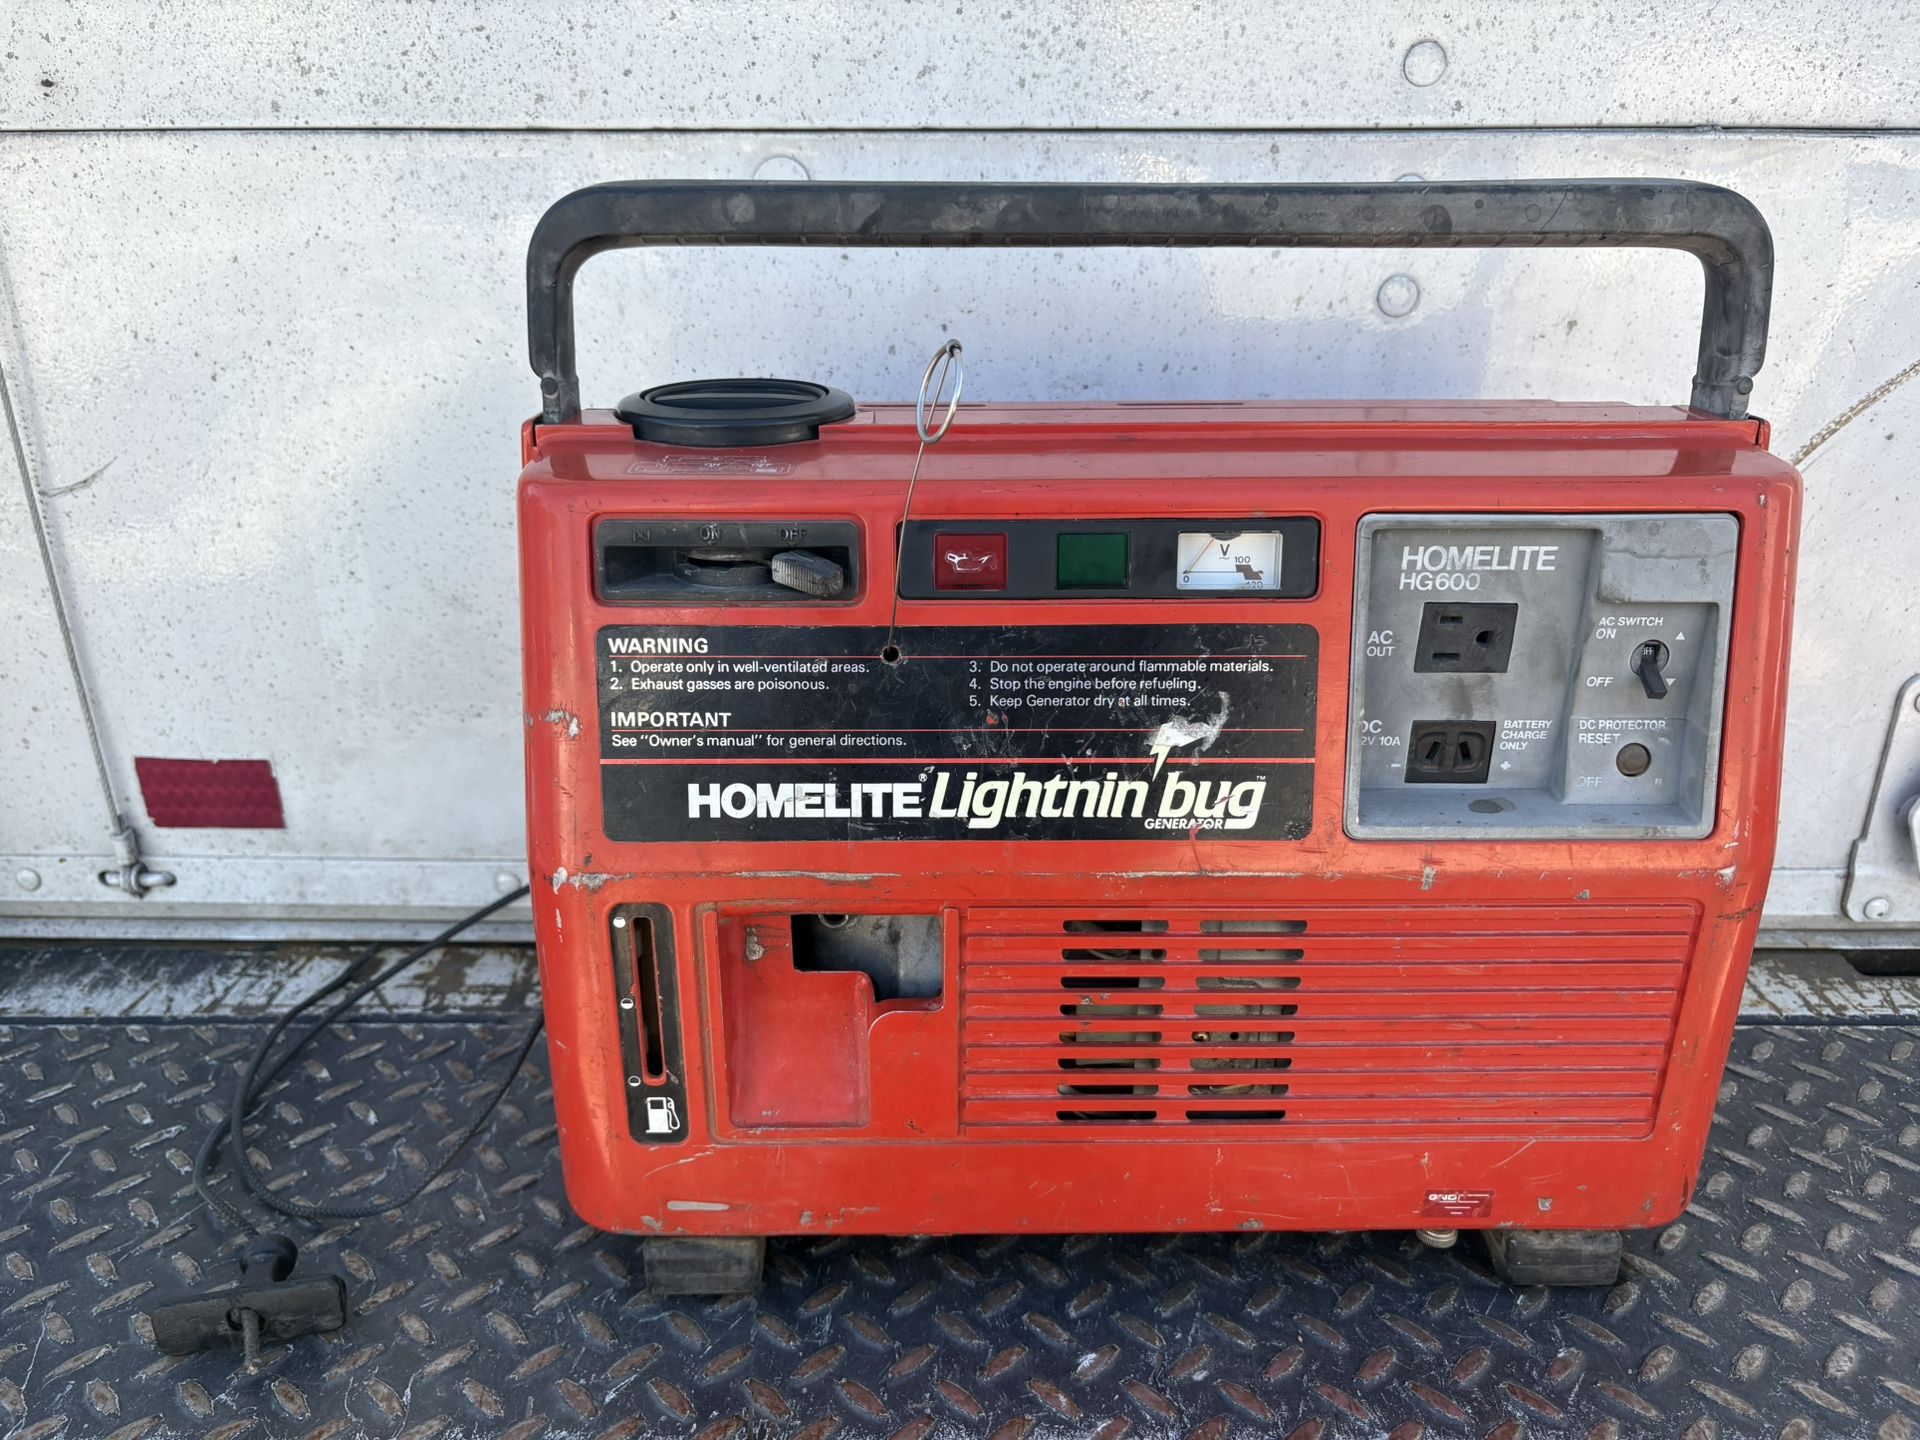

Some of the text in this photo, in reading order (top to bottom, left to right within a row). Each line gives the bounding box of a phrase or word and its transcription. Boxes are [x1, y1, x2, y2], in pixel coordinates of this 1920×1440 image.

[699, 524, 807, 540] ON OFF
[1219, 544, 1230, 556] V
[1234, 555, 1251, 564] 100
[1401, 545, 1559, 571] HOMELITE
[1183, 575, 1190, 583] 0
[1399, 573, 1481, 591] HG600
[1598, 616, 1664, 627] AC SWITCH
[1367, 629, 1393, 644] AC
[1595, 628, 1617, 640] ON
[608, 638, 708, 654] WARNING
[1366, 645, 1396, 657] OUT
[610, 659, 869, 675] 1. Operate only in well-ventilated areas.
[969, 660, 1274, 675] 3. Do not operate around flammable materials.
[610, 677, 829, 693] 2. Exhaust gasses are poisonous.
[969, 677, 1202, 692] 4. Stop the engine before refueling.
[1586, 676, 1614, 687] OFF
[969, 694, 1191, 710] 5. Keep Generator dry at all times.
[611, 712, 732, 727] IMPORTANT
[1503, 719, 1553, 729] BATTERY
[1578, 719, 1666, 731] DC PROTECTOR
[1360, 735, 1401, 746] 2V 10A
[1501, 730, 1549, 740] CHARGE
[1577, 733, 1621, 744] RESET
[612, 734, 637, 747] See
[766, 734, 784, 747] for
[789, 734, 836, 749] general
[839, 734, 907, 747] directions.
[1500, 741, 1529, 750] ONLY
[688, 782, 923, 819] HOMELITE
[928, 771, 1149, 829] Lightnin
[1157, 772, 1267, 830] bug
[1144, 818, 1224, 830] GENERATOR
